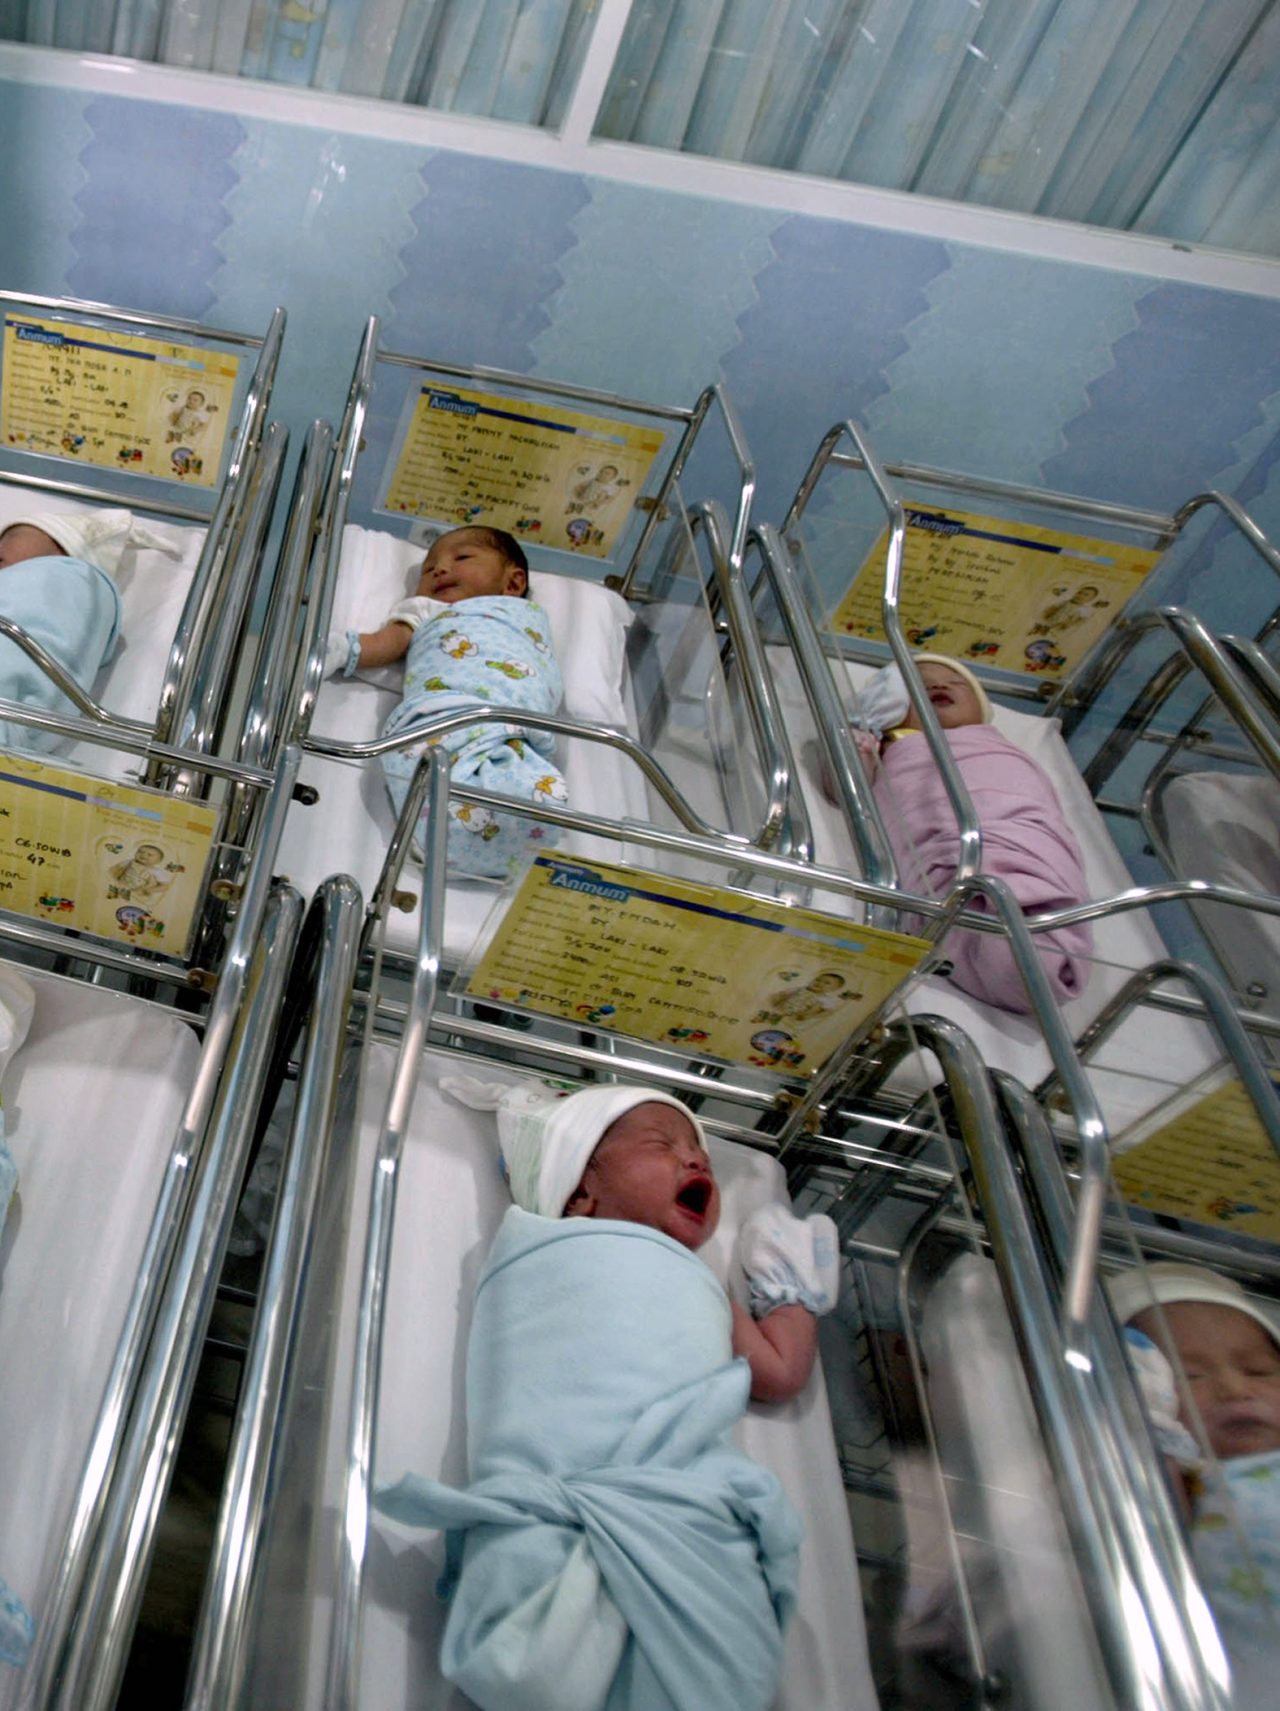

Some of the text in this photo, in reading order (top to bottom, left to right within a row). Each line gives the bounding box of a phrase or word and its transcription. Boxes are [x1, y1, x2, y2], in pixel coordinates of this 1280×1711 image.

[431, 396, 477, 415] Anmum
[911, 517, 960, 535] Anmum
[551, 872, 627, 902] Anmum
